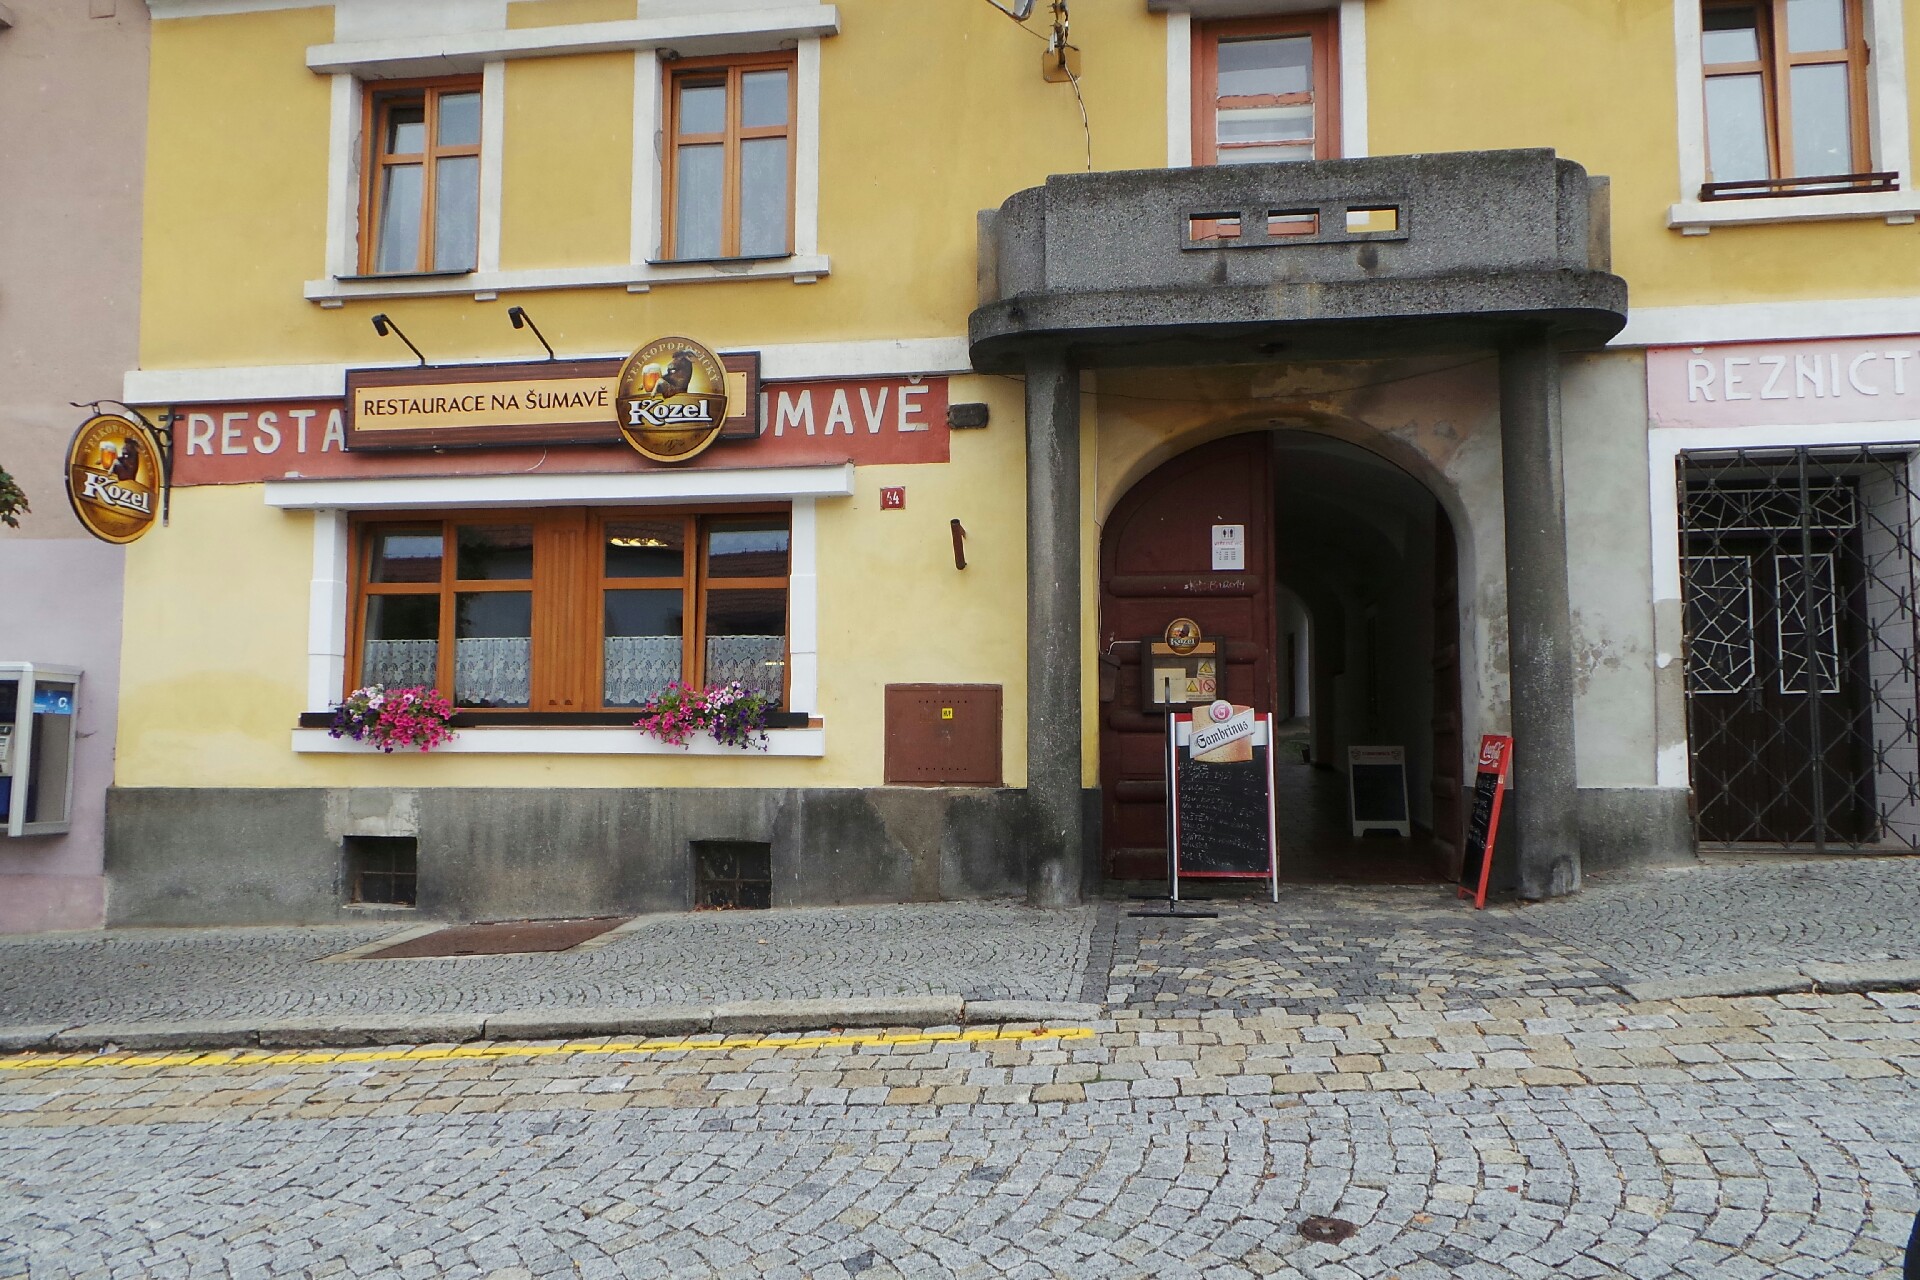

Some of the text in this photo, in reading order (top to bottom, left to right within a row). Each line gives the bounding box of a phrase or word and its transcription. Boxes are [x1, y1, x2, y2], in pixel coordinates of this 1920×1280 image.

[1687, 348, 1919, 402] ŘEZNICT
[364, 386, 608, 416] RESTAURACE NA ŠUMAVĚ
[628, 399, 712, 426] Kozel
[186, 408, 345, 455] RESTA
[82, 471, 150, 513] Kozel
[886, 491, 900, 505] 44
[1170, 638, 1195, 646] Kozel
[1196, 721, 1249, 749] Gambrinus
